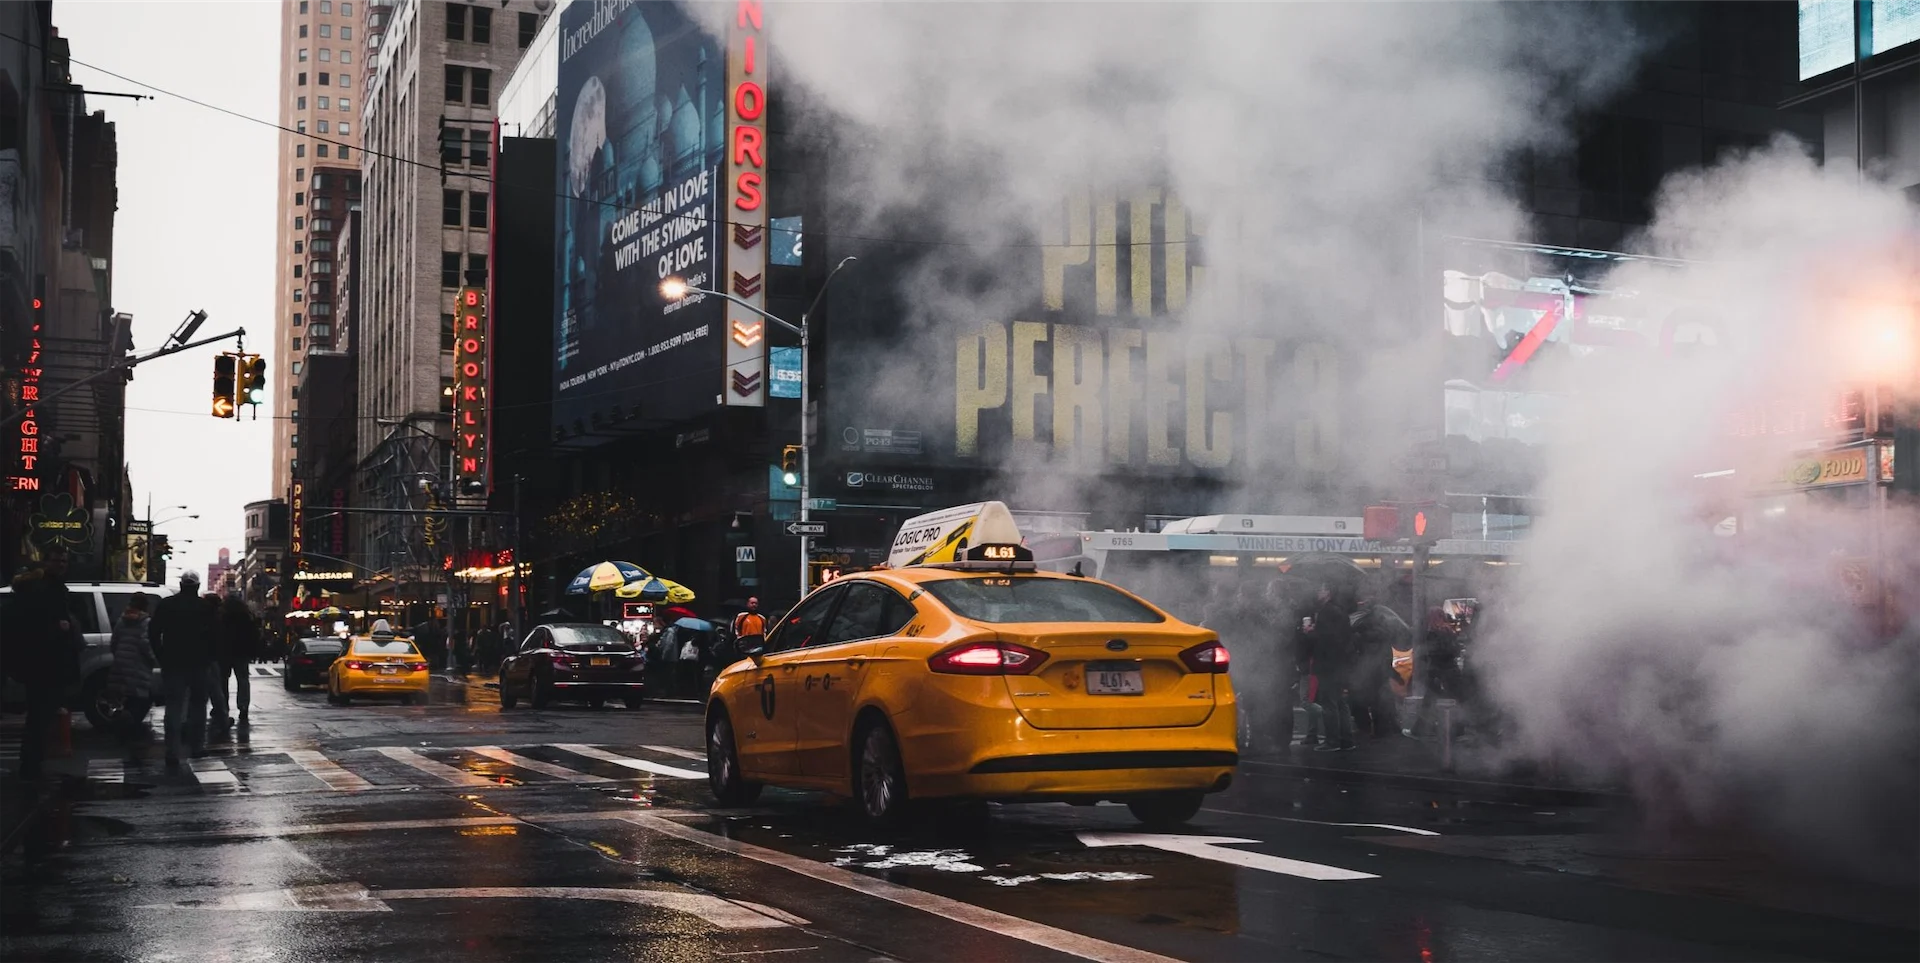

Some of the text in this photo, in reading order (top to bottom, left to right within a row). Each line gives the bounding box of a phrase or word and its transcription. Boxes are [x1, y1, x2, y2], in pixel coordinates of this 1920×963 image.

[612, 170, 708, 245] COME FALL IN LOVE
[615, 204, 707, 272] WITH THE SYMBOL
[658, 236, 707, 279] OF LOVE.
[1041, 183, 1210, 318] PITC
[463, 291, 479, 473] BROOKLYN
[587, 369, 597, 380] NEW
[597, 365, 608, 376] YORK
[956, 319, 1275, 472] PERFECT
[865, 437, 891, 446] PG-13
[1824, 457, 1863, 478] FOOD
[293, 484, 302, 538] park
[819, 500, 826, 508] 7
[895, 526, 941, 547] LOGIC PRO
[1111, 538, 1133, 546] 6765
[1237, 538, 1294, 551] WINNER
[1309, 538, 1348, 551] TONY
[984, 546, 1016, 559] 4L61
[293, 571, 353, 580] AMBASSADOR
